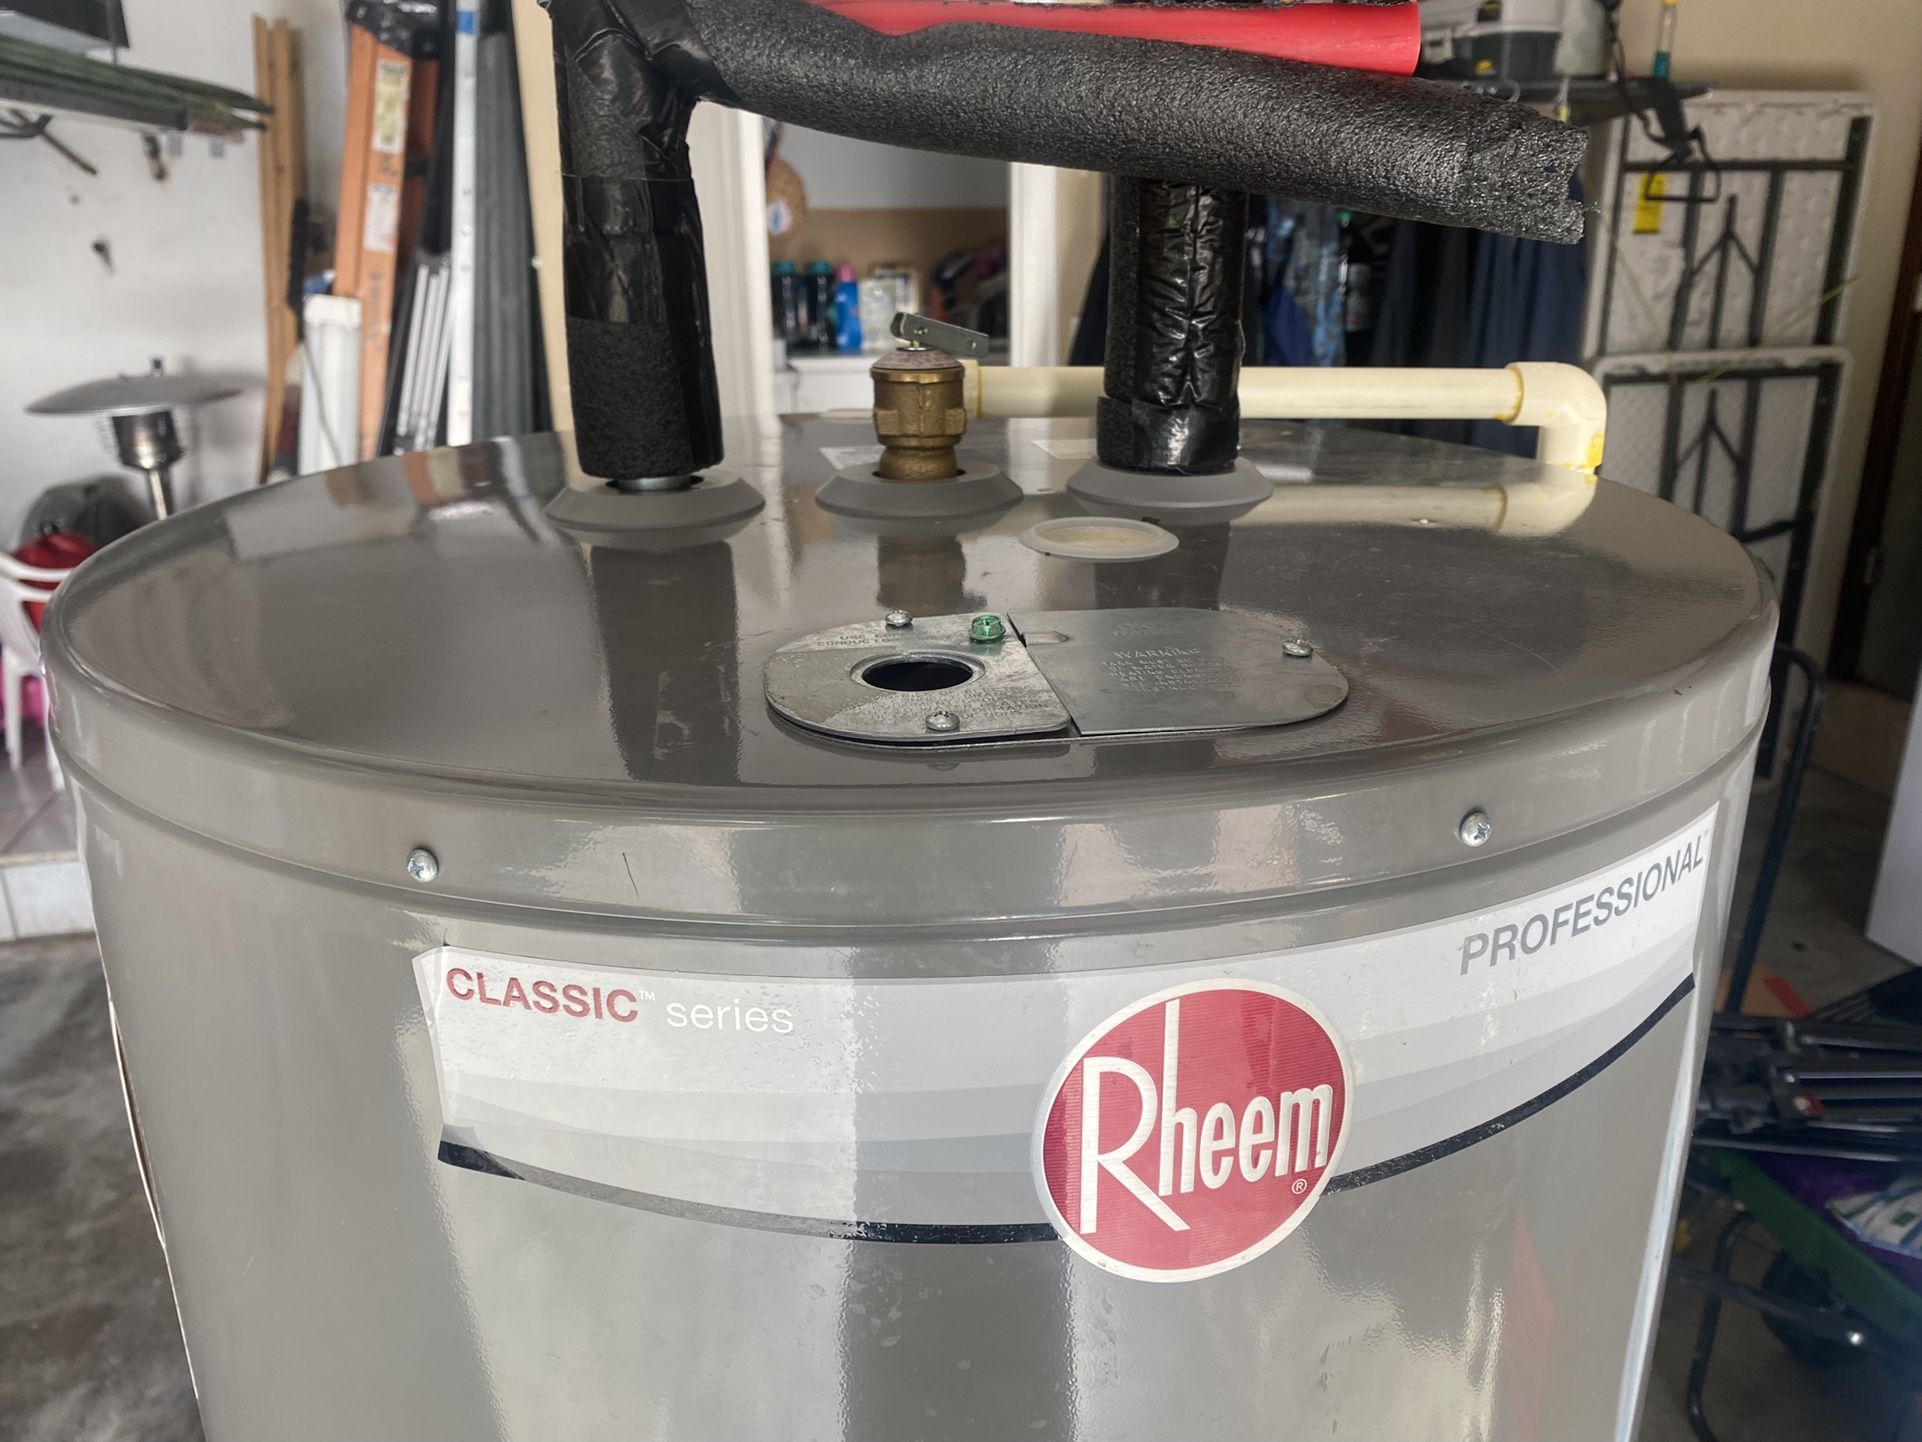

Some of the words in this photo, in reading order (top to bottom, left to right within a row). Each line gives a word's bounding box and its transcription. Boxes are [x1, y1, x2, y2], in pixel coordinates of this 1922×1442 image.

[1458, 834, 1704, 976] PROFESSIONAL
[446, 967, 639, 1023] CLASSIC
[665, 998, 795, 1035] series
[1079, 998, 1334, 1235] Rheem
